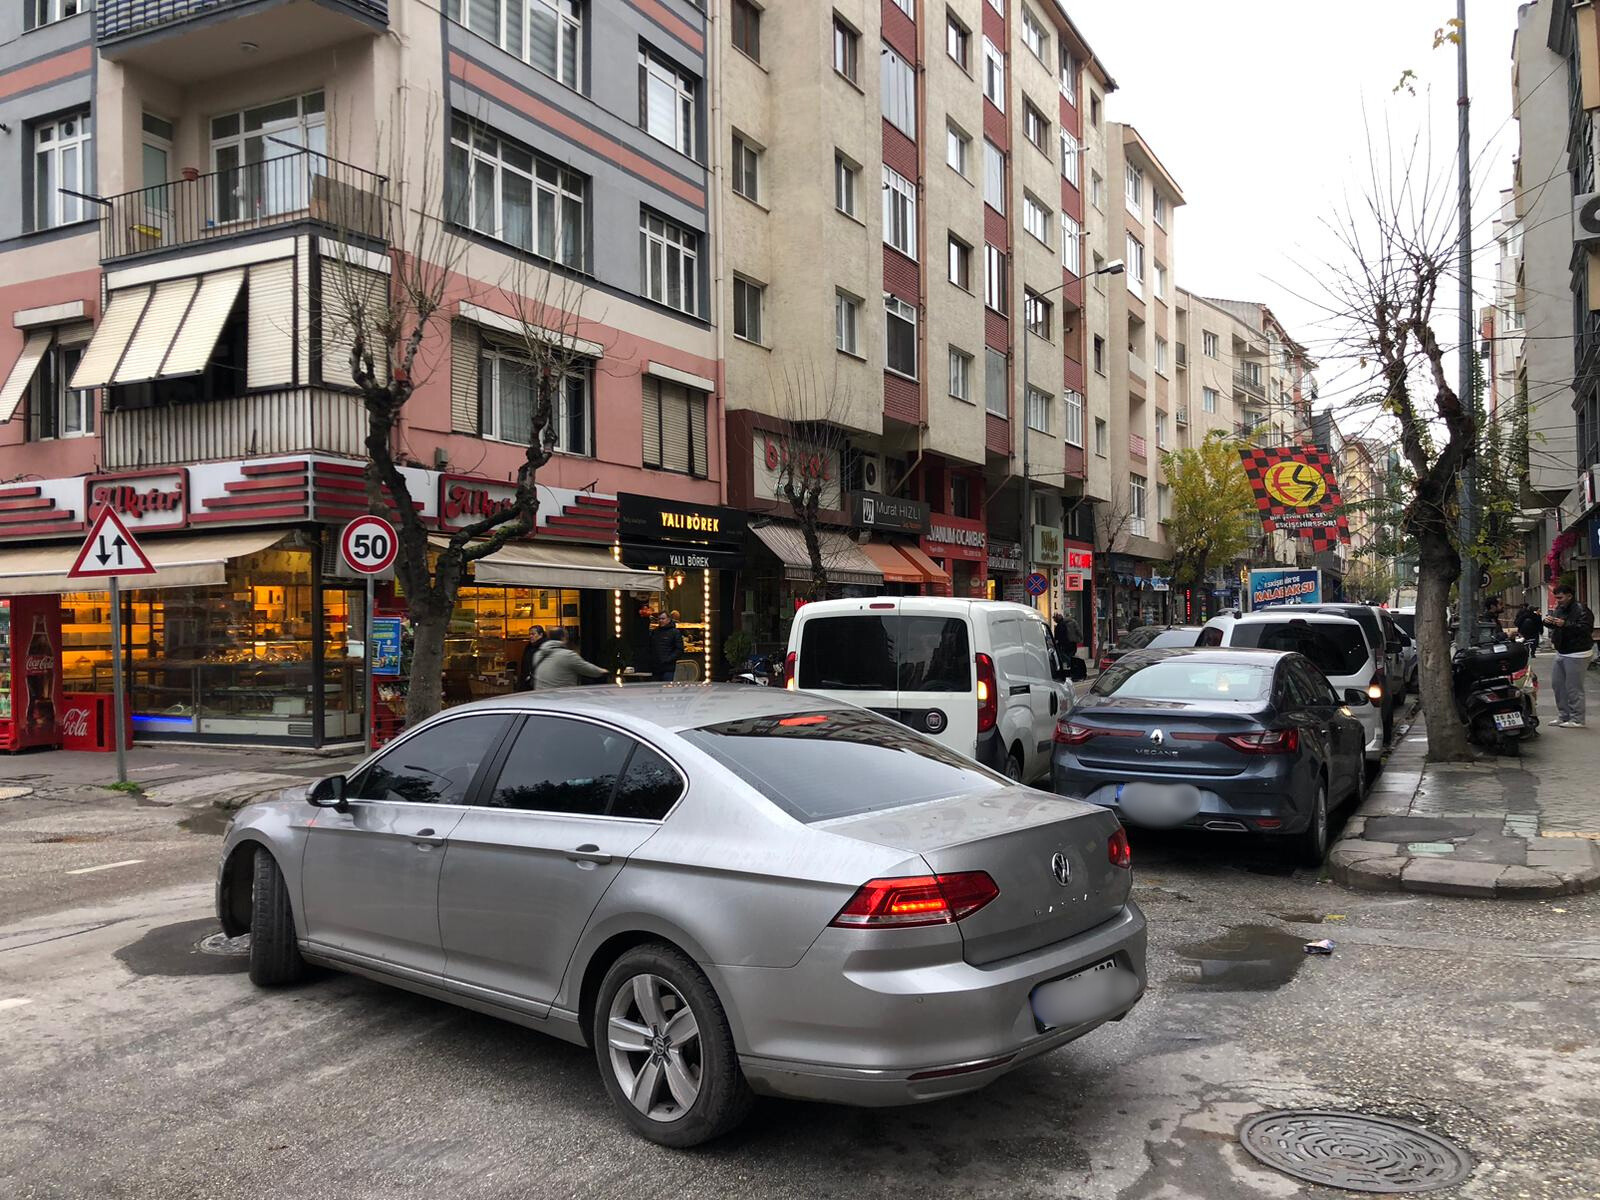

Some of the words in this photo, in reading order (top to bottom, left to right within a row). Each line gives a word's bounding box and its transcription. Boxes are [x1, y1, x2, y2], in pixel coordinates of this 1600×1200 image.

[876, 501, 897, 517] Murat
[661, 512, 684, 528] YALI
[686, 513, 719, 532] BÖREK
[354, 534, 388, 560] 50
[670, 555, 686, 566] YALI
[687, 553, 709, 568] BÖREK
[1301, 581, 1315, 593] SU
